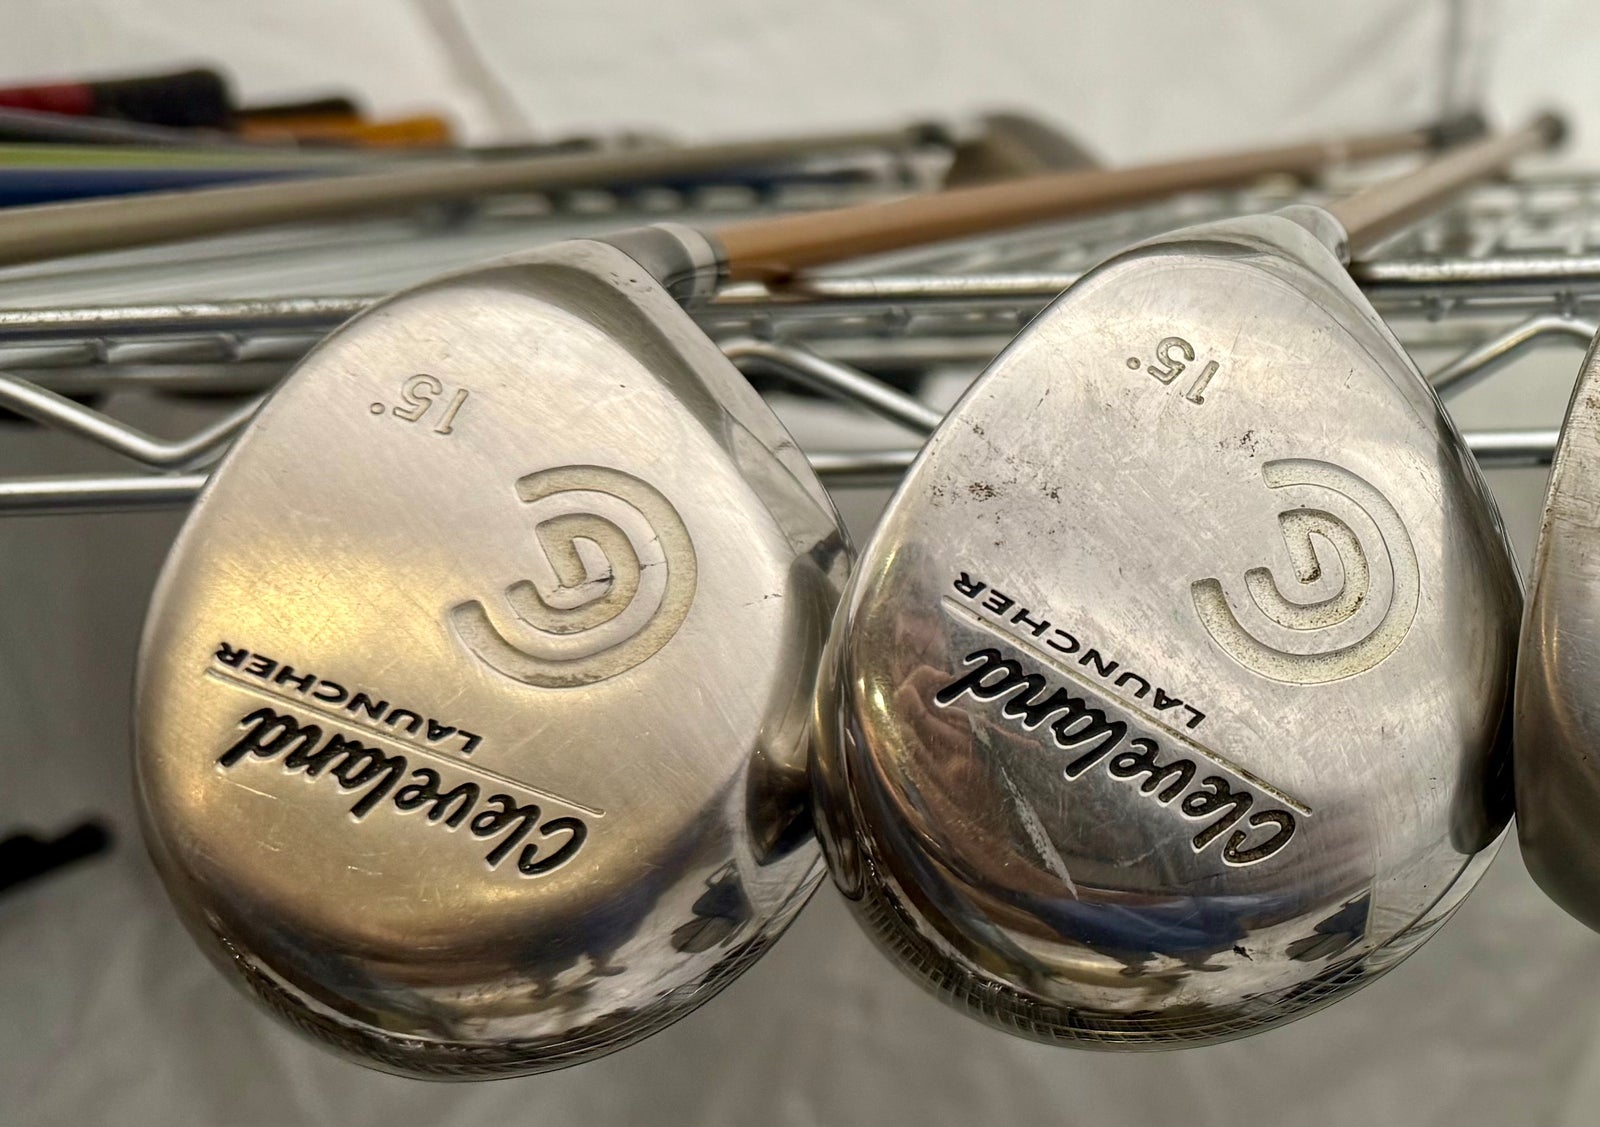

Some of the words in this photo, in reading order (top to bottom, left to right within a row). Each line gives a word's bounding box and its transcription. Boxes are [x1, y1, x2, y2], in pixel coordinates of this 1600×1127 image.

[214, 641, 482, 754] LAUNCHER
[952, 570, 1205, 730] LAUNCHER
[220, 707, 587, 876] Cleveland
[935, 648, 1298, 866] Cleveland
